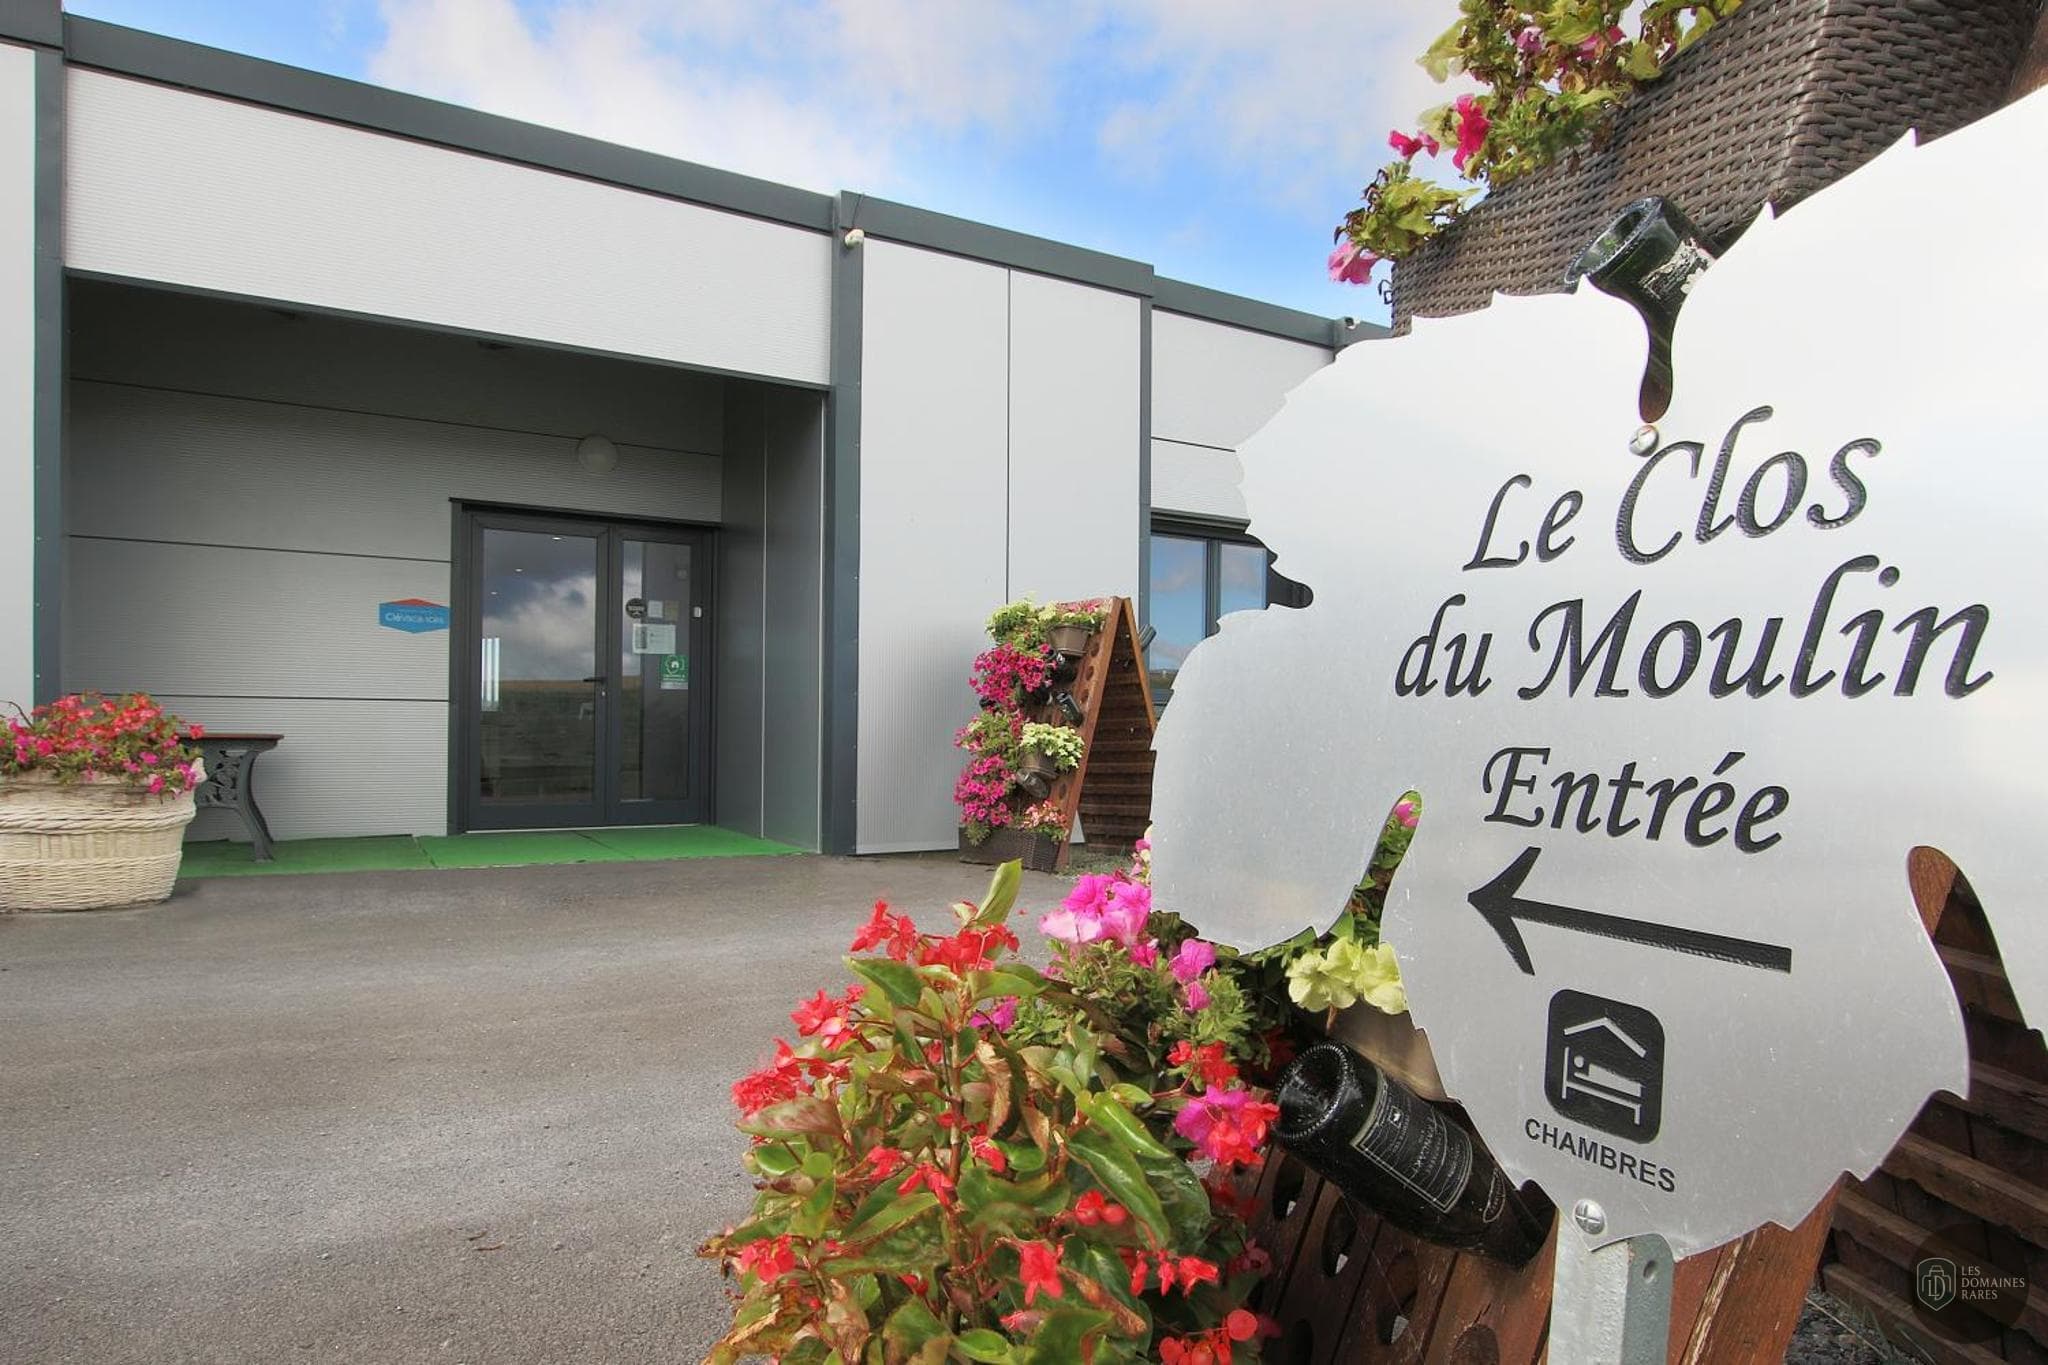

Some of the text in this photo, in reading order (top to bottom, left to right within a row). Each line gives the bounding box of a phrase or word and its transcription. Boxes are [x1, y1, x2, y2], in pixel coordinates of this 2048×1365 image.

[1463, 405, 1881, 572] Le Clos
[1395, 554, 1994, 701] du Moulin
[1482, 746, 1790, 854] Entrée
[1524, 1118, 1677, 1193] CHAMBRES
